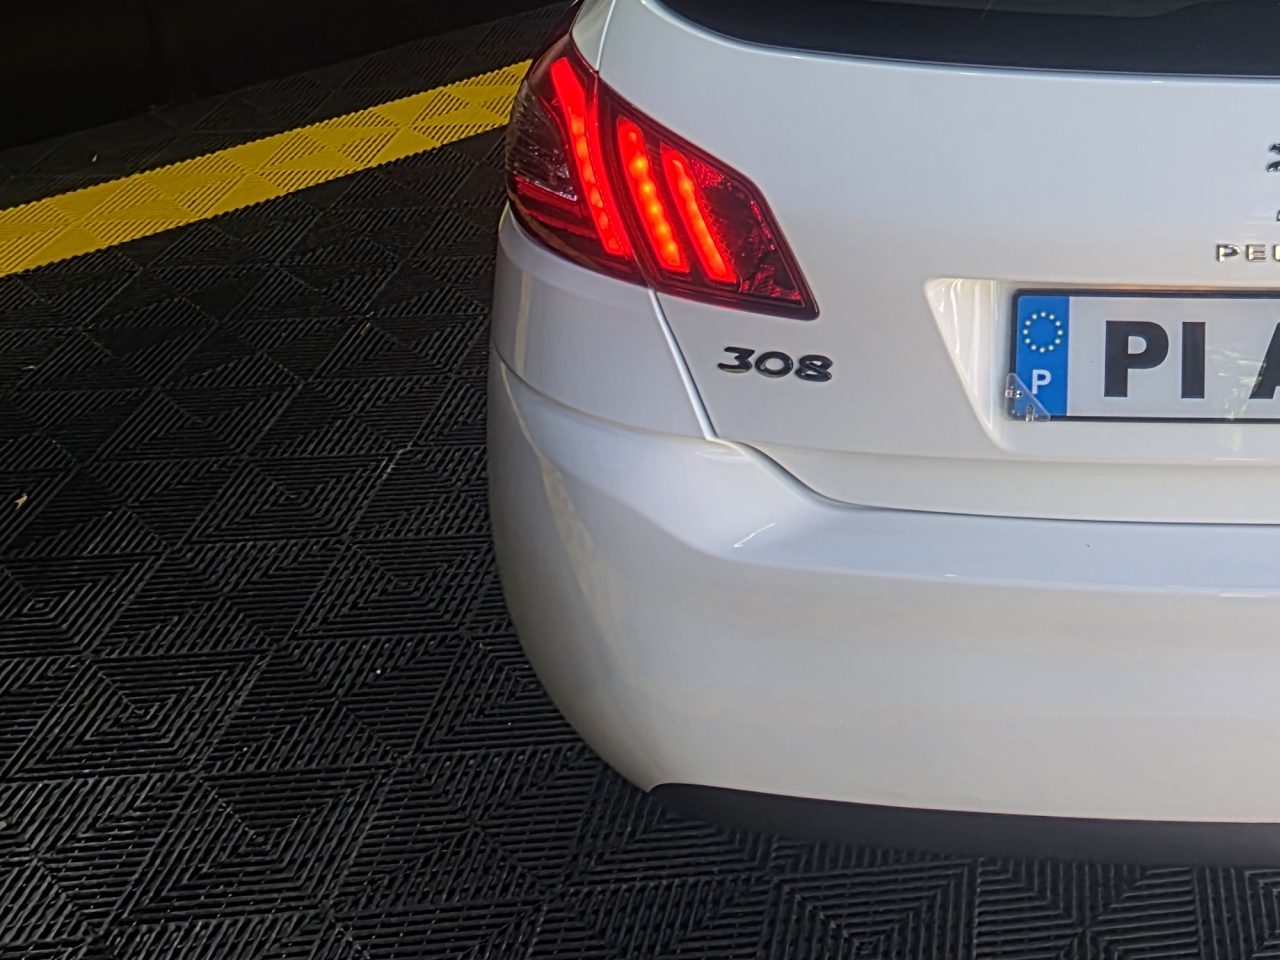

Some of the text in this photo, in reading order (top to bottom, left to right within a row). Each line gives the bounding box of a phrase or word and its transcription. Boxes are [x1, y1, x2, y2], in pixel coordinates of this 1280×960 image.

[717, 346, 833, 382] 308
[1103, 320, 1206, 398] PI
[1032, 369, 1052, 394] P
